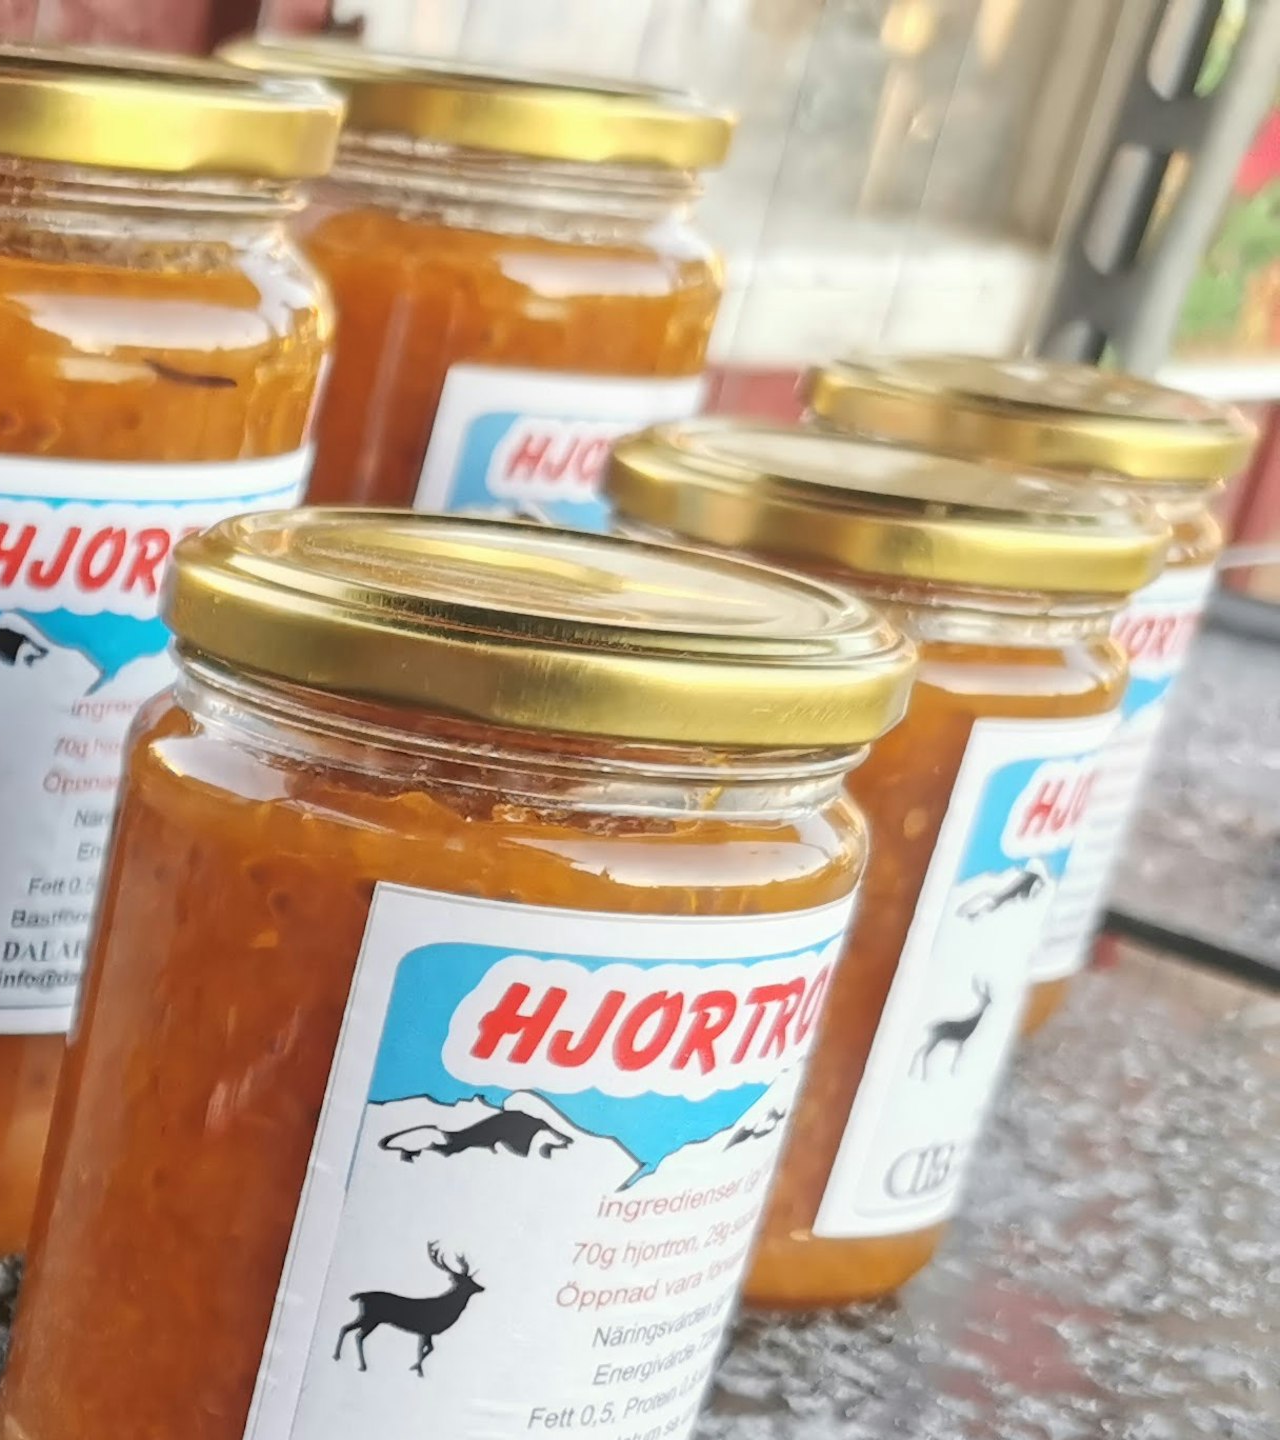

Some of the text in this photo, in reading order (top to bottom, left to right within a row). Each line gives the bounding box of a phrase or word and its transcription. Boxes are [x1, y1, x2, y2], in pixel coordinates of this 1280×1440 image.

[596, 1175, 743, 1223] ingredienser
[572, 1241, 617, 1270] 70g
[556, 1279, 659, 1312] Öppnad
[527, 1406, 575, 1430] Fett
